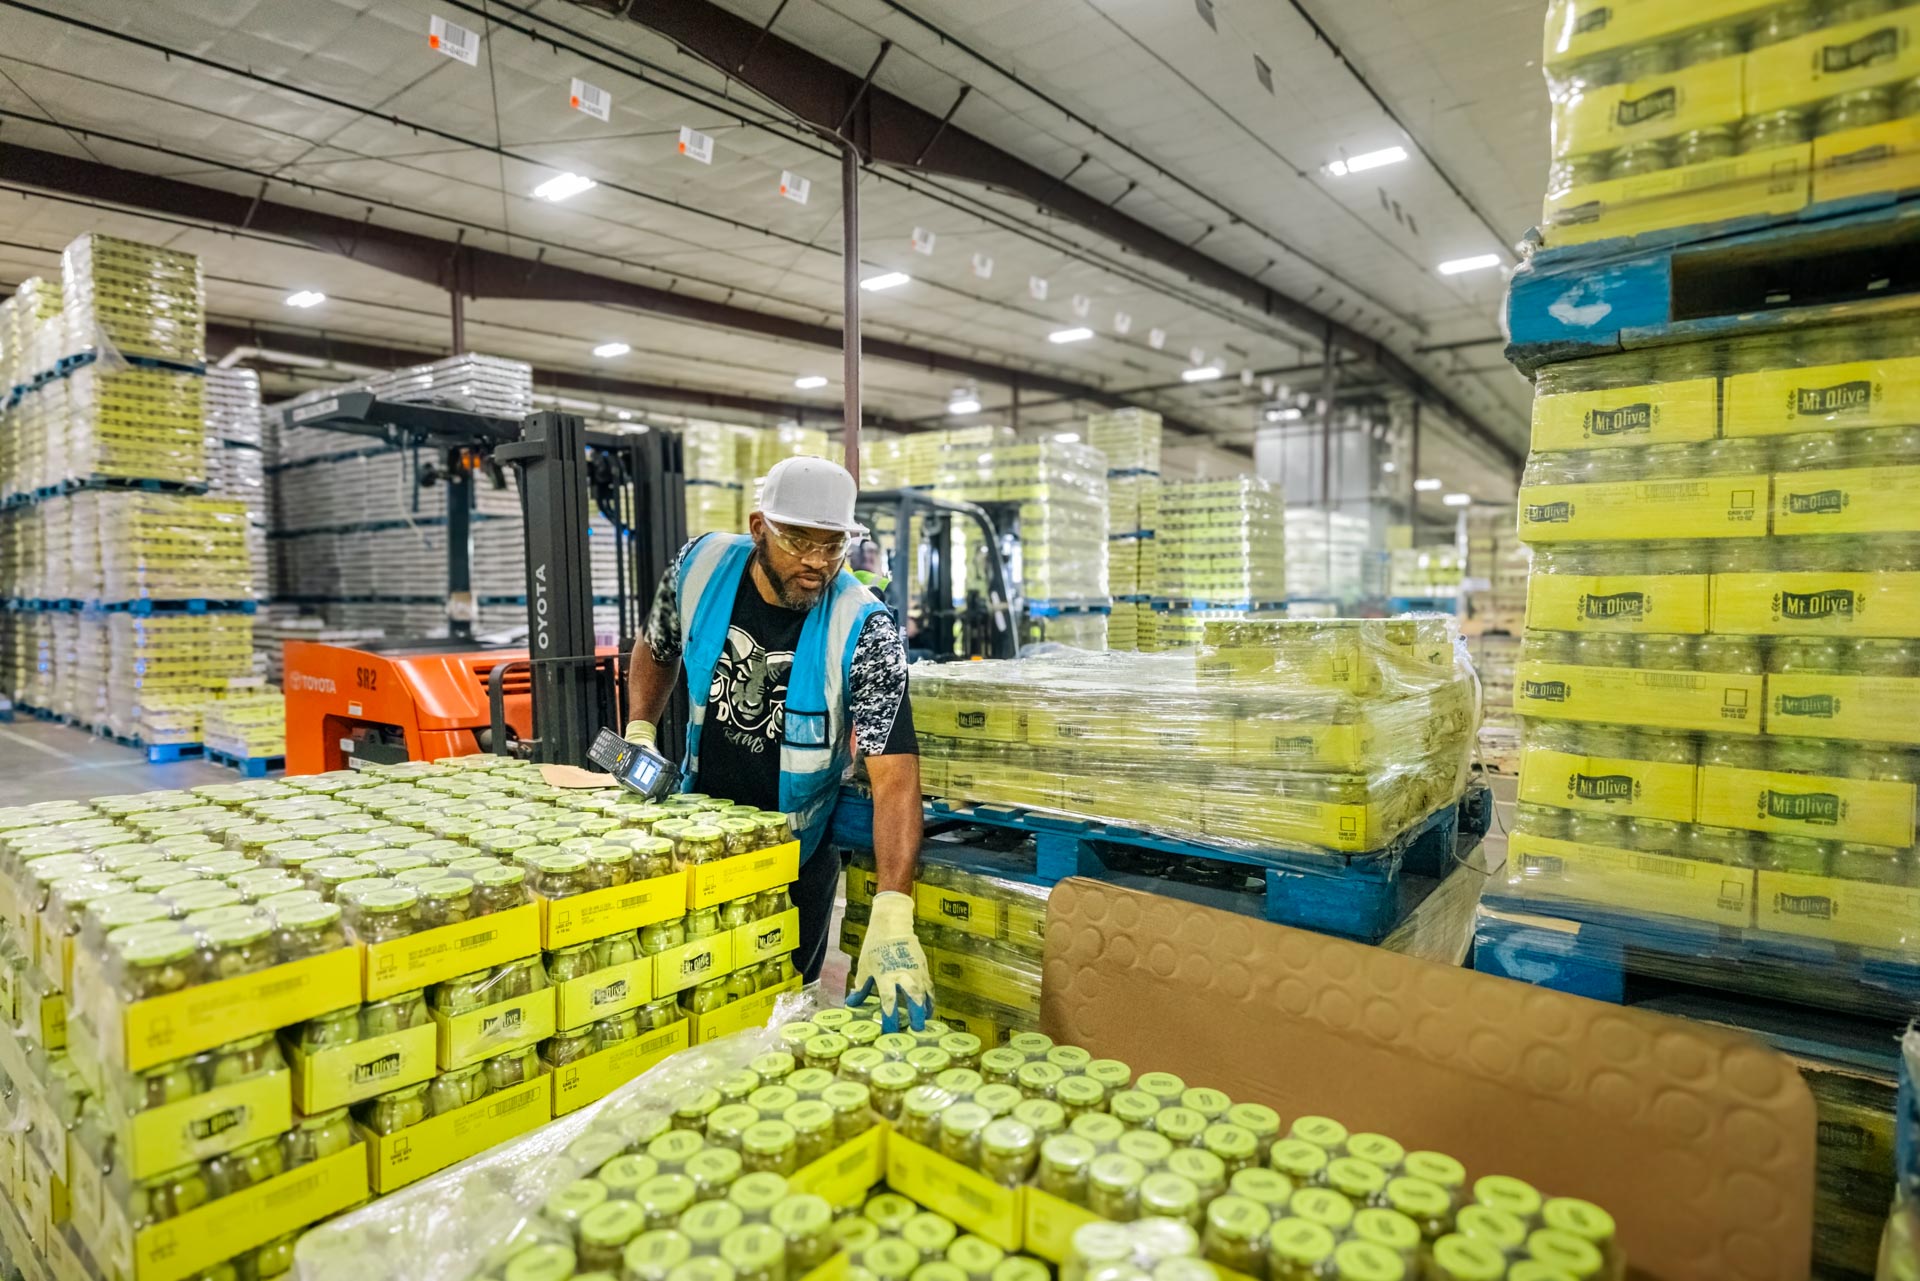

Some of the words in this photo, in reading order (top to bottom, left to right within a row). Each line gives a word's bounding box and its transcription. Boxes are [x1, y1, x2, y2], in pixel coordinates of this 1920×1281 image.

[1801, 393, 1822, 411] Mt.
[1825, 386, 1866, 407] Olive
[1595, 416, 1611, 431] Mt.
[1613, 408, 1647, 428] Olive
[1809, 493, 1839, 509] Olive
[1589, 599, 1607, 616] Mt.
[1606, 597, 1640, 615] Olive
[1787, 599, 1807, 615] Mt.
[1808, 596, 1848, 615] Olive
[301, 674, 337, 695] TOYOTA
[356, 667, 377, 691] SR2
[1540, 684, 1563, 698] Olive
[1801, 699, 1831, 715] Olive
[1579, 778, 1595, 796] Mt.
[1596, 779, 1628, 796] Olive
[1772, 798, 1793, 815] Mt.
[1795, 798, 1833, 815] Olive
[952, 903, 968, 915] Olive
[1800, 898, 1829, 913] Olive
